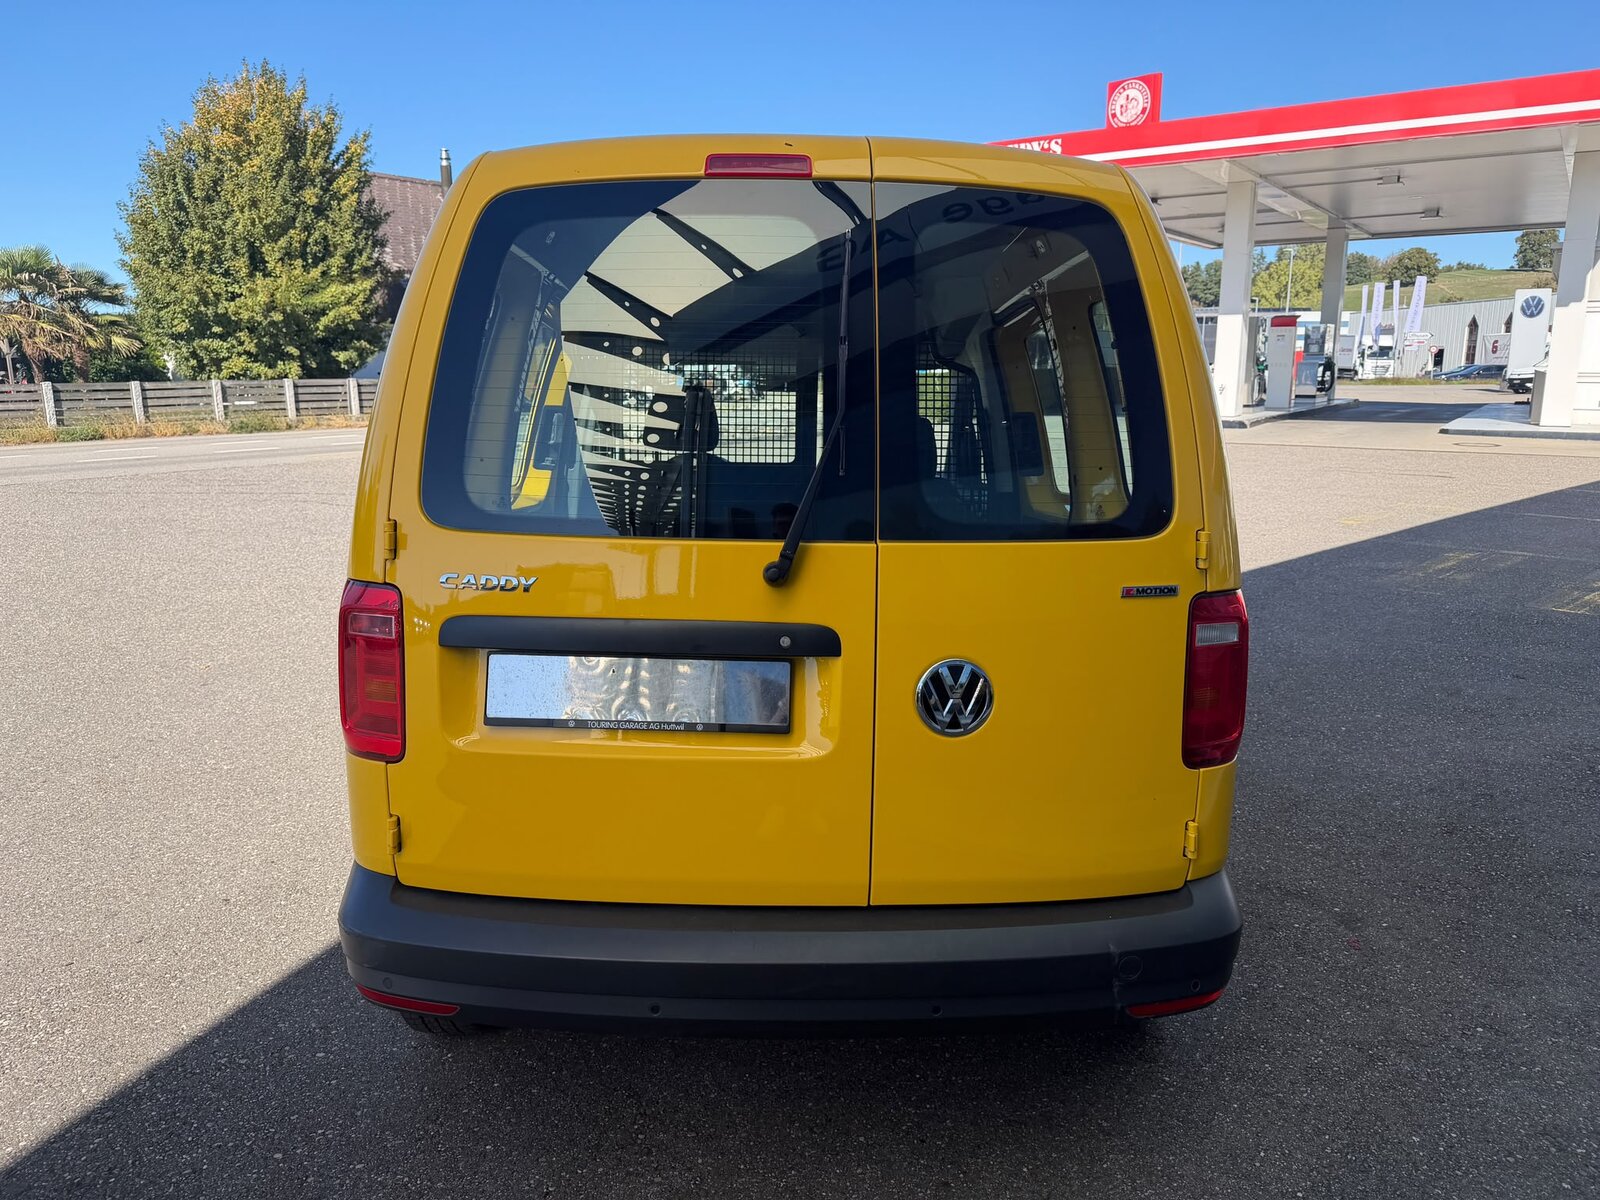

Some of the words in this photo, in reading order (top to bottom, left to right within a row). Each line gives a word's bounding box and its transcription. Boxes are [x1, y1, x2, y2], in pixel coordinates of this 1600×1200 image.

[440, 573, 538, 592] CADDY
[587, 721, 618, 729] TOURING
[620, 721, 648, 730] GARAGE
[648, 722, 660, 730] AG
[661, 723, 685, 731] Huttwil
